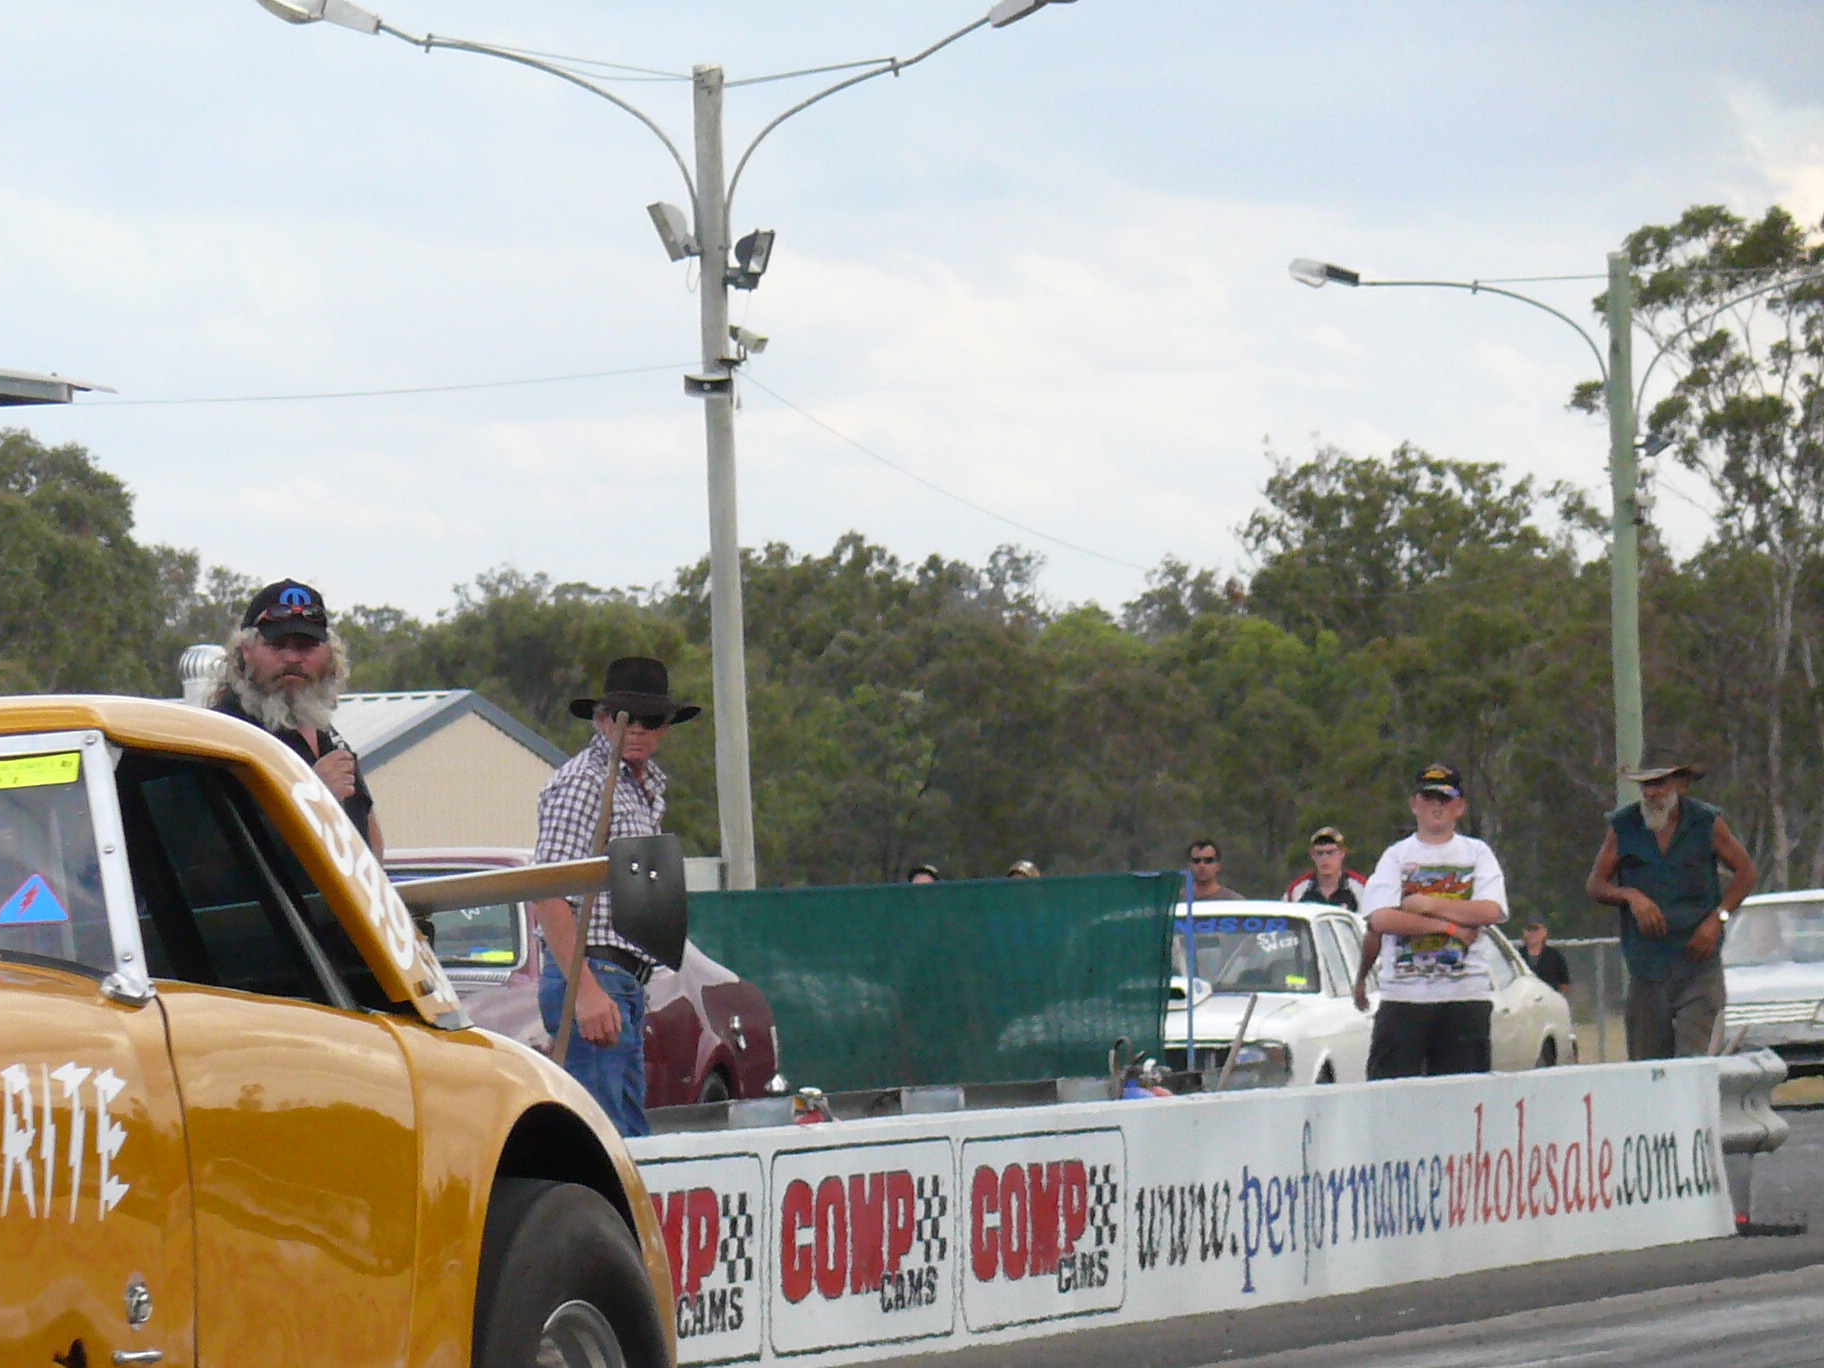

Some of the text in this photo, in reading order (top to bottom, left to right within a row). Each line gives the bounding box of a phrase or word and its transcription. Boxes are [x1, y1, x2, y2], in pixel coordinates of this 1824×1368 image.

[650, 1187, 720, 1294] MP
[781, 1170, 915, 1305] COMP
[972, 1159, 1088, 1283] COMP
[880, 1265, 939, 1314] CAMS
[1057, 1249, 1109, 1294] CAMS
[677, 1287, 744, 1338] CAMS
